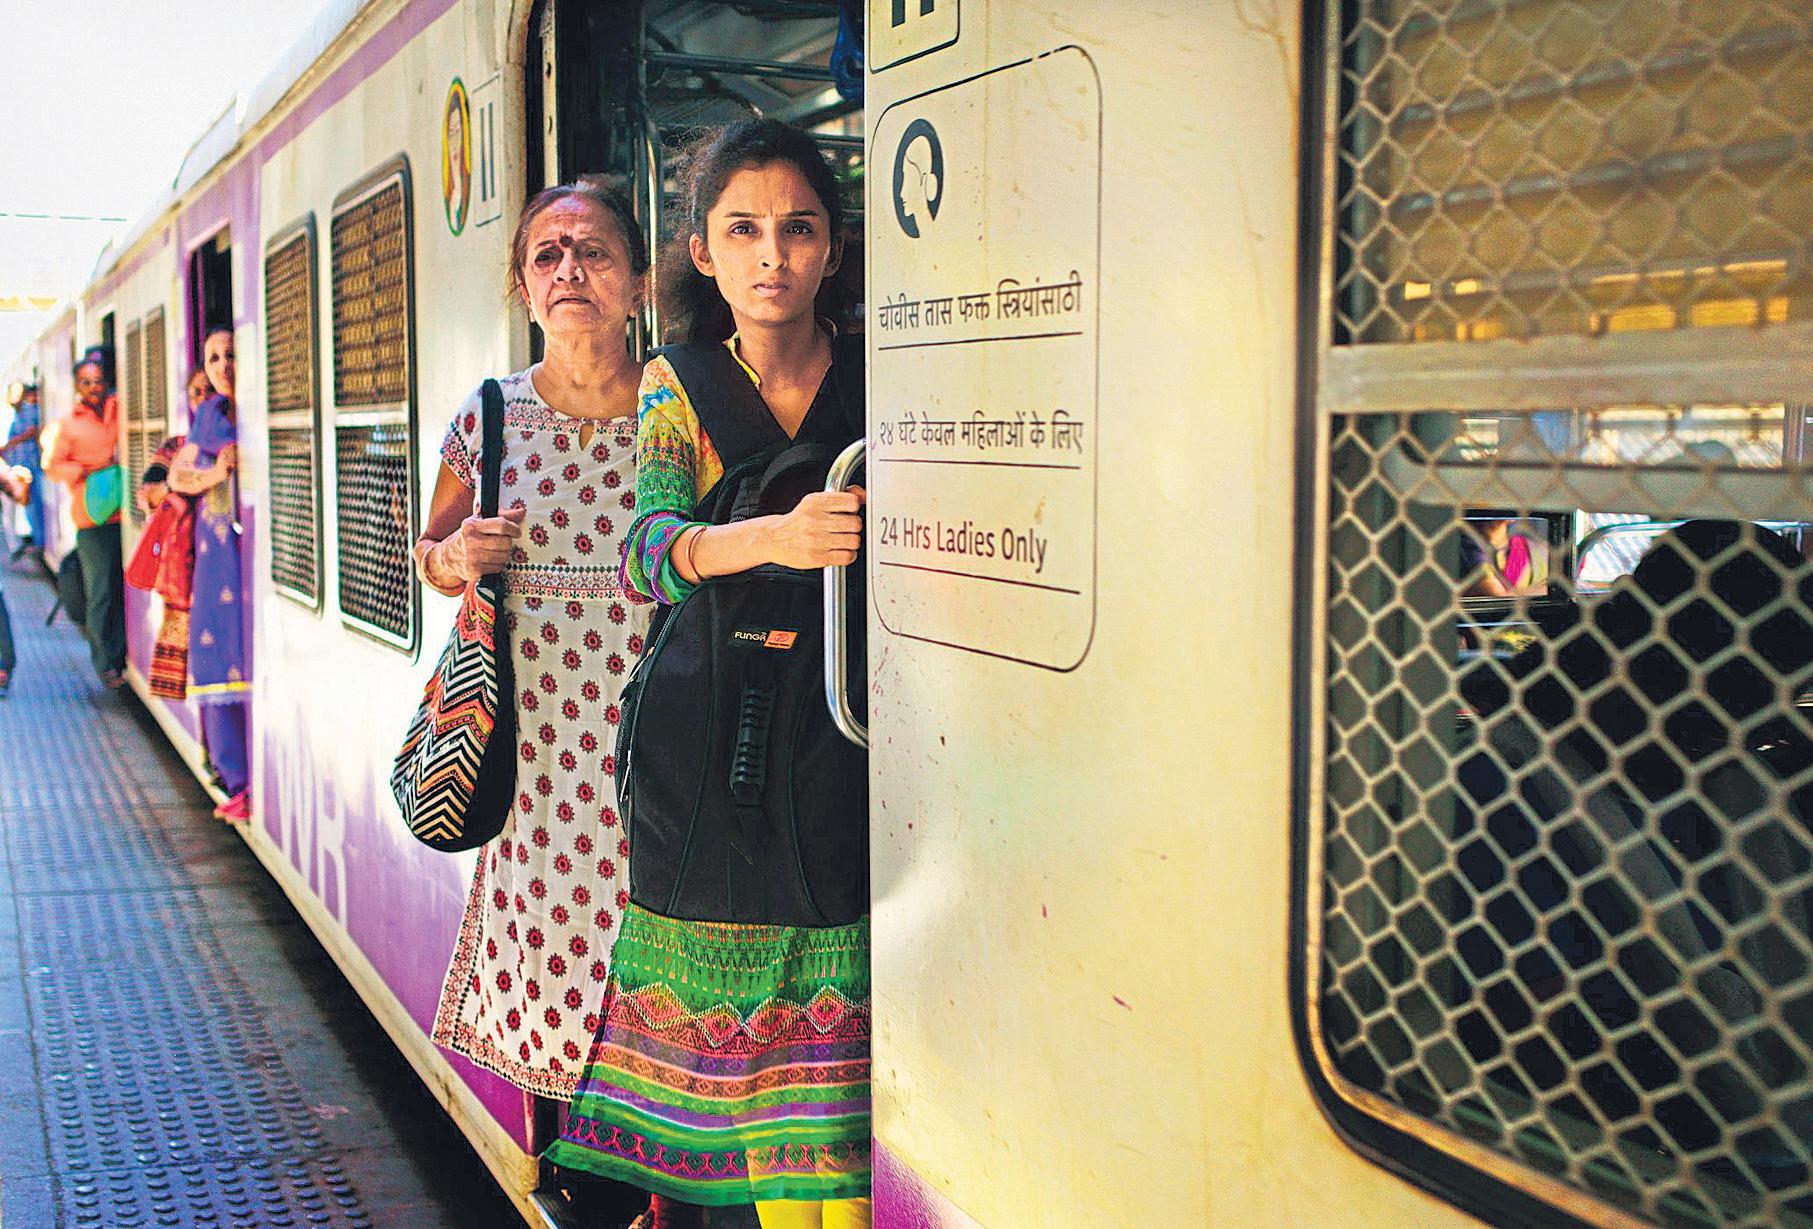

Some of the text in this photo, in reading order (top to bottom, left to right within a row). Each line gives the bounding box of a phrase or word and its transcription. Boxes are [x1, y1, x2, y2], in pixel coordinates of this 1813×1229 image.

[879, 293, 920, 331] चोवीस
[924, 297, 953, 327] तास
[996, 270, 1083, 320] स्त्रियांसाठी
[898, 411, 917, 446] घंटे
[921, 411, 956, 446] केवल
[961, 410, 1024, 450] महिलाओं
[1029, 411, 1046, 448] के
[1051, 409, 1084, 453] लिए
[880, 516, 1048, 574] 24 Hrs Ladies Only
